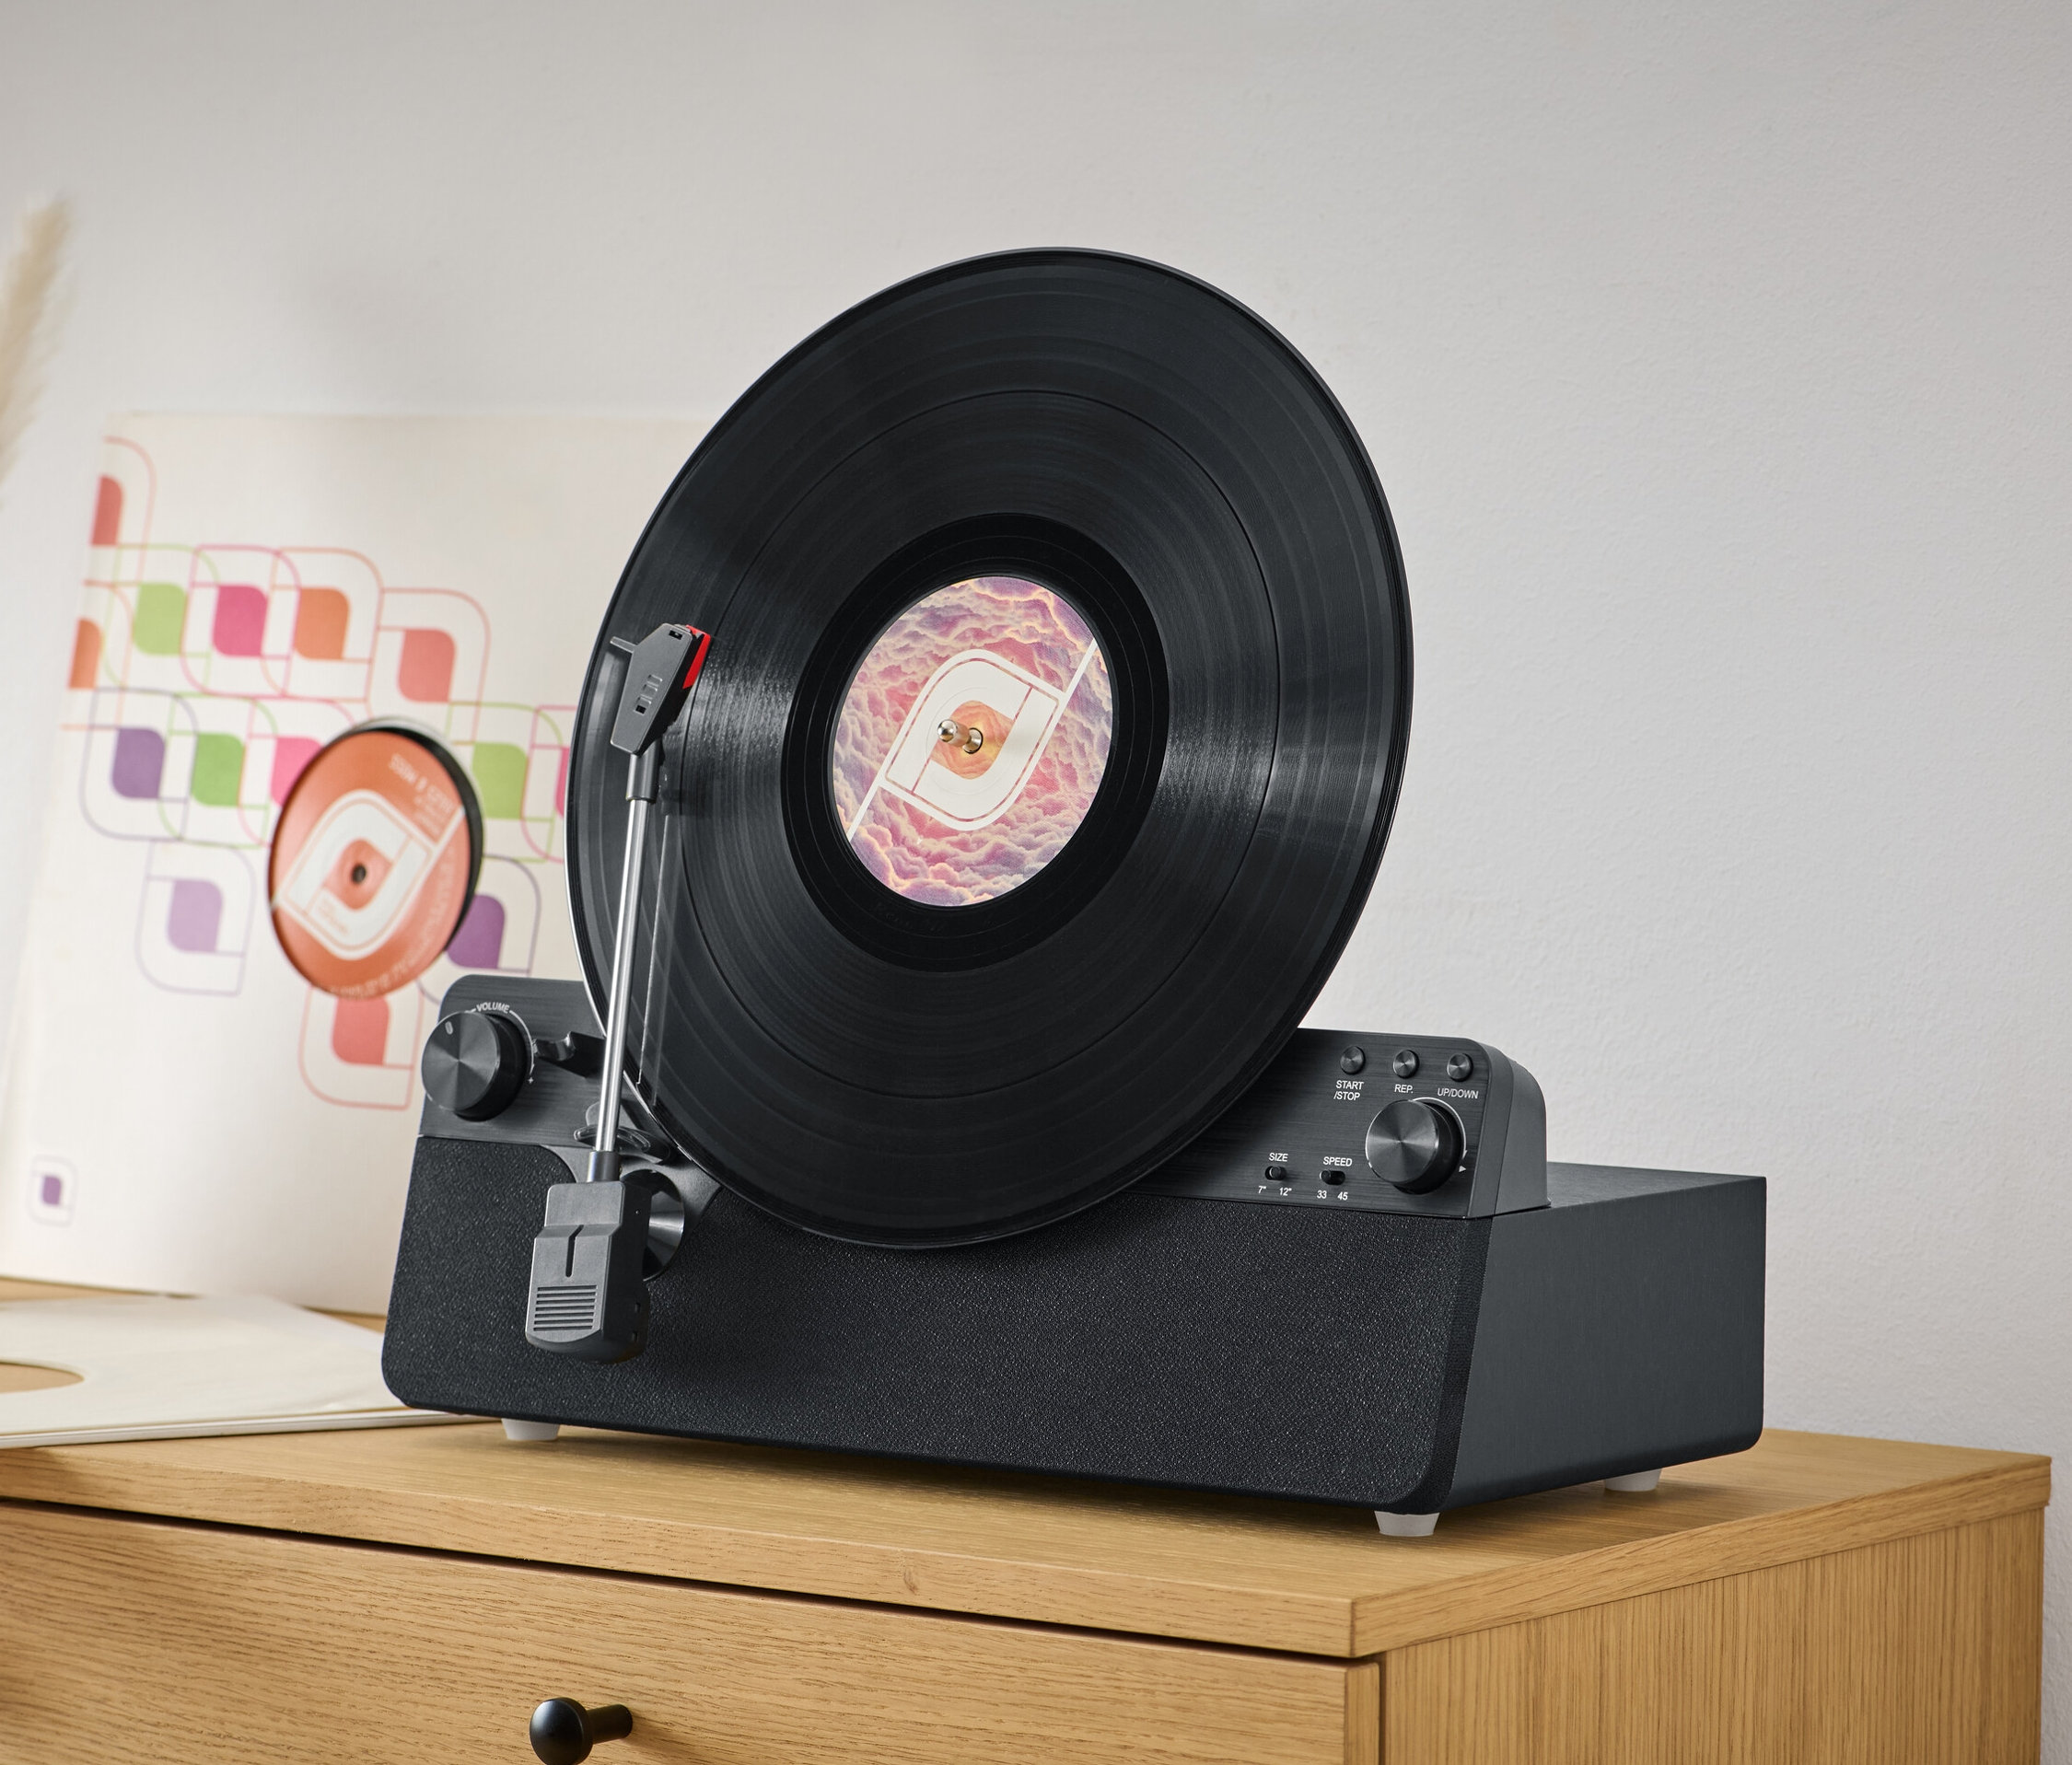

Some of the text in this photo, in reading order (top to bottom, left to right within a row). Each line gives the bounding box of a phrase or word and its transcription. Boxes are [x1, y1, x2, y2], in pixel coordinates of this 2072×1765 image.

[476, 1002, 510, 1013] VOLUME
[1335, 1079, 1365, 1091] START
[1394, 1084, 1414, 1094] REP.
[1333, 1090, 1361, 1101] /STOP
[1437, 1087, 1479, 1099] UP/DOWN
[1268, 1152, 1288, 1163] SIZE
[1322, 1156, 1353, 1167] SPEED
[1317, 1190, 1348, 1202] 33 45
